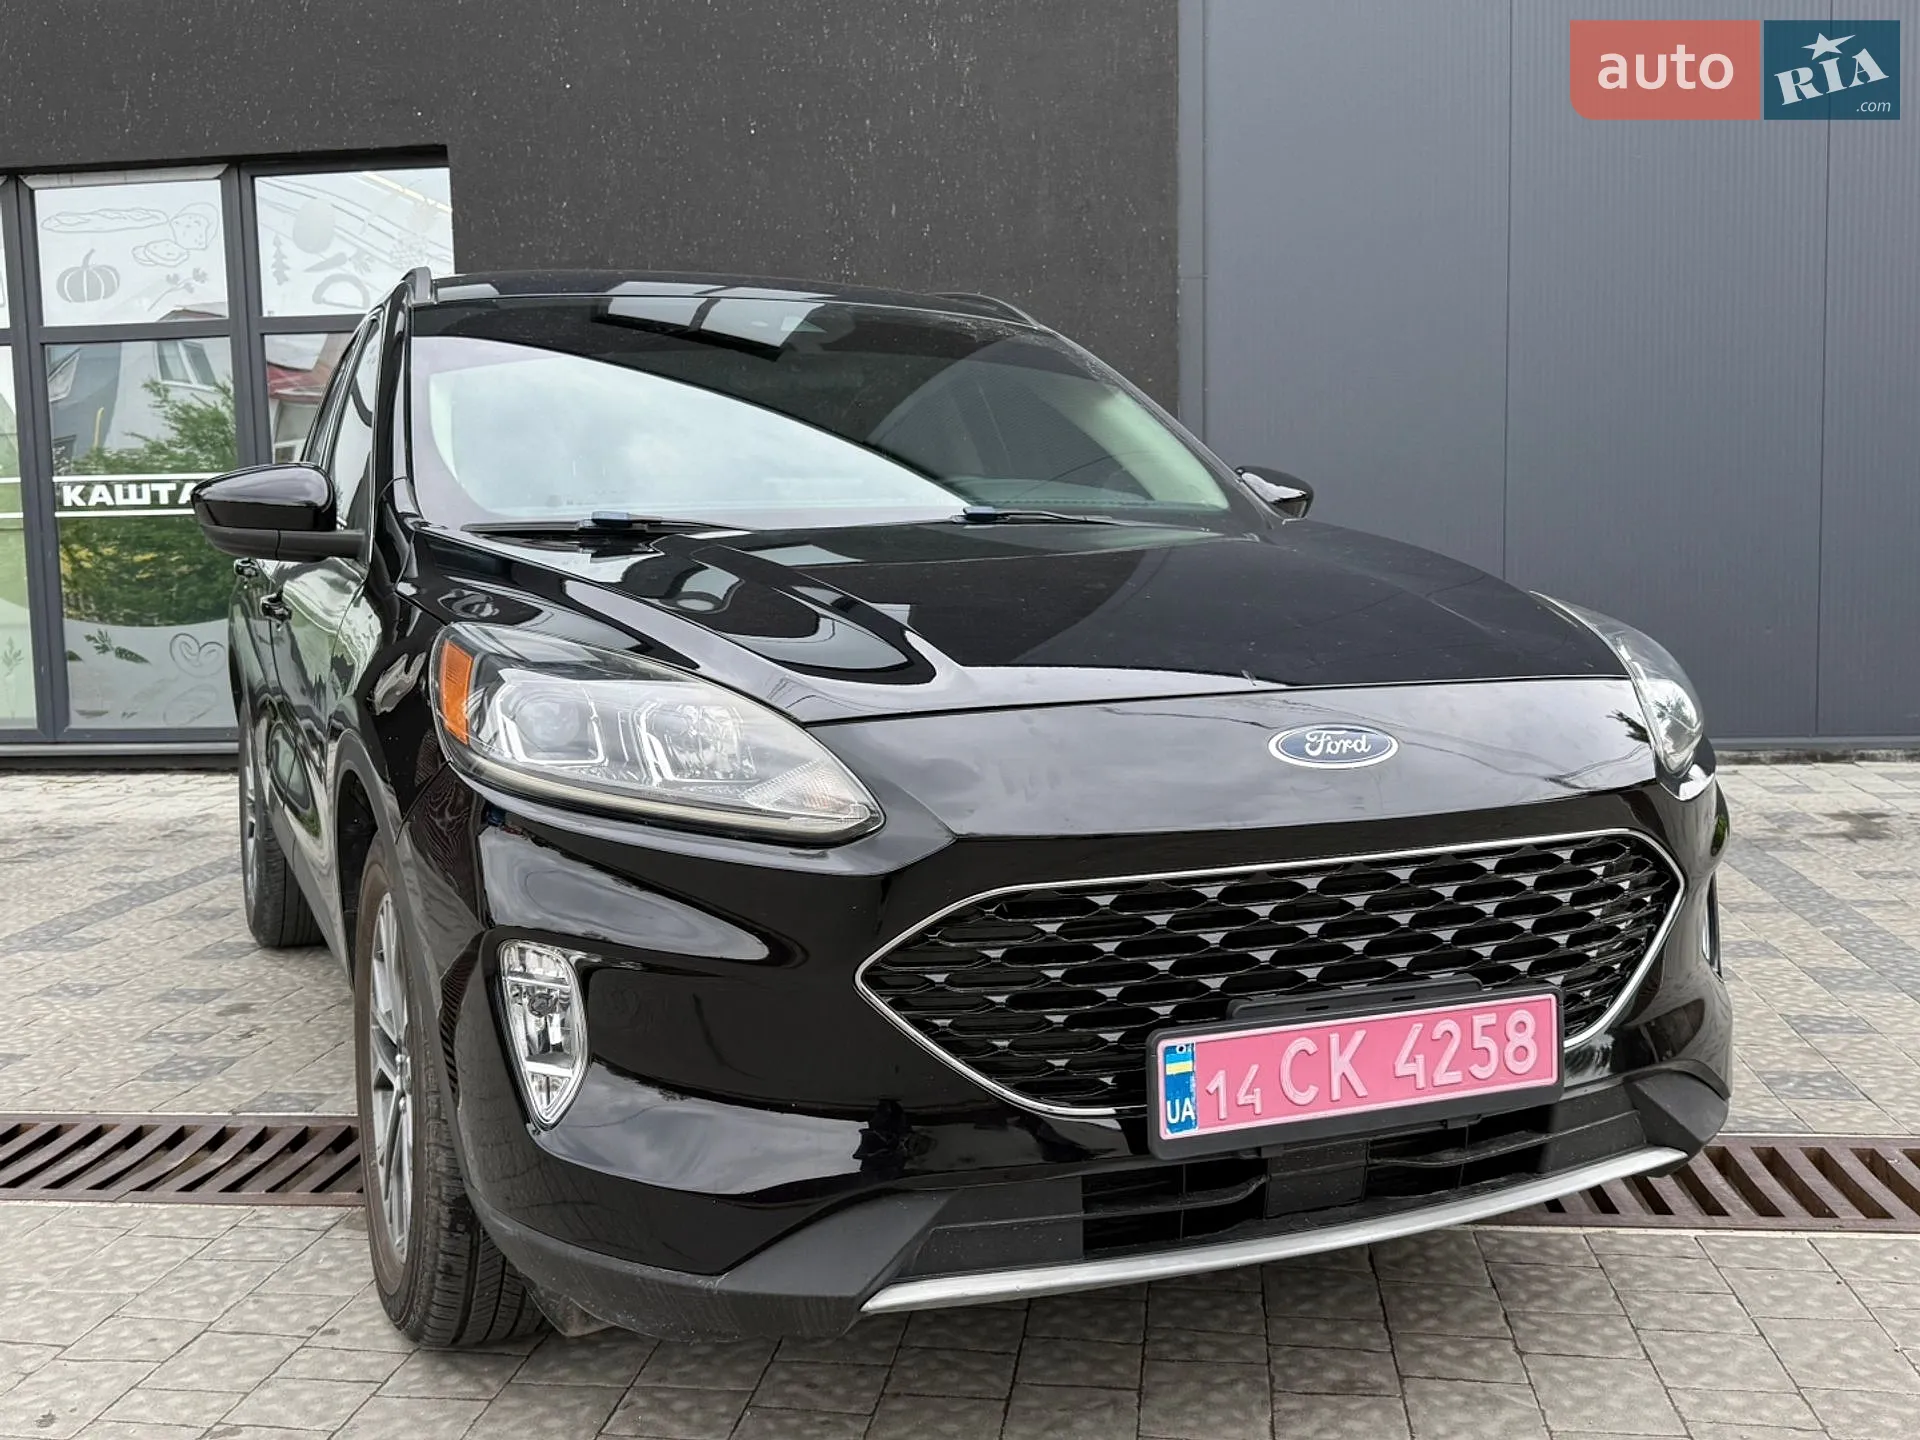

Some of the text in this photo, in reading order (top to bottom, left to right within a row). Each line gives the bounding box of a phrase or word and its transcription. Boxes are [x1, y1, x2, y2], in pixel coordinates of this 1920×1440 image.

[1304, 730, 1372, 757] Ford
[1205, 1008, 1538, 1120] 14 CK 4258
[1166, 1097, 1196, 1124] UA
